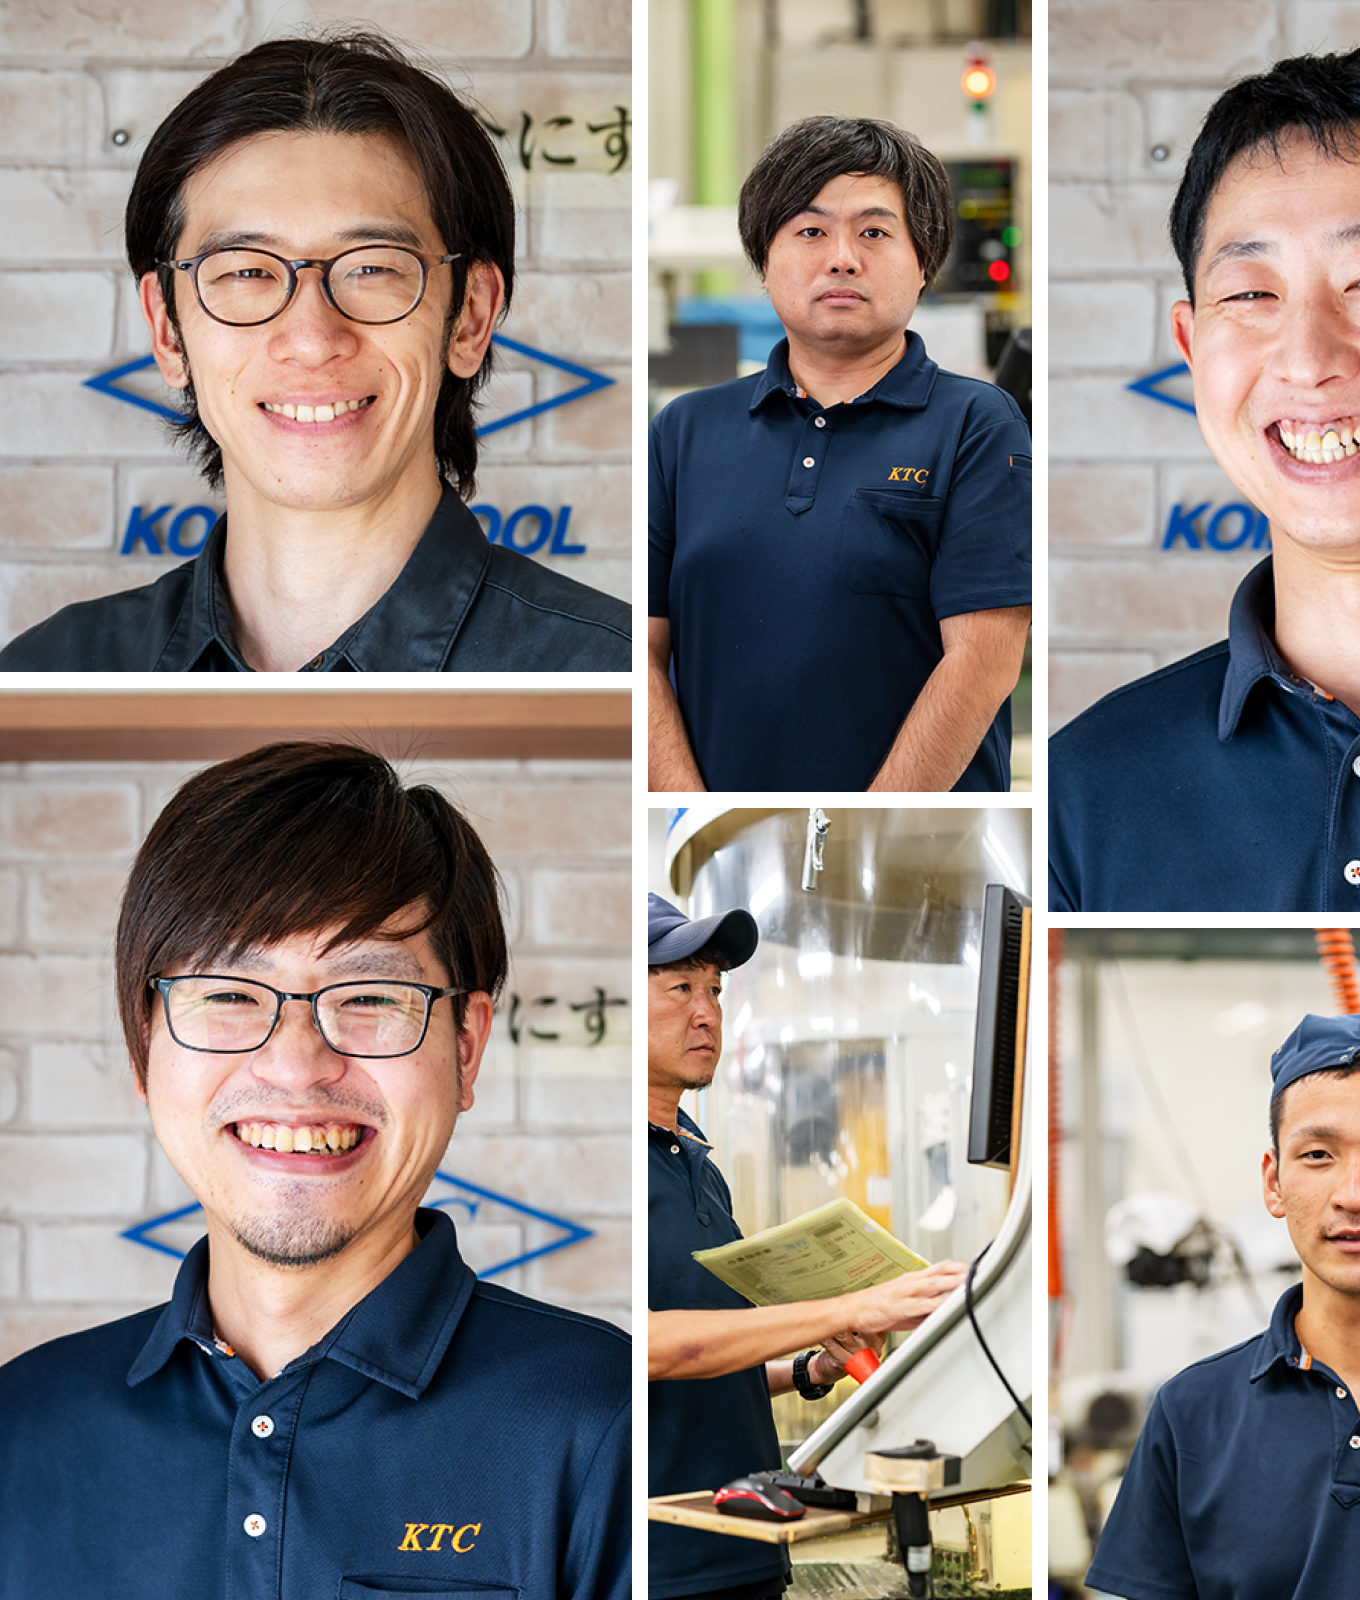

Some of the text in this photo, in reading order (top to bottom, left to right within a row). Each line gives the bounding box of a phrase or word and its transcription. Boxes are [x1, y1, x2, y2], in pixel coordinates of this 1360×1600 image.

[888, 466, 930, 485] KTC
[120, 504, 587, 557] KO OOL
[1162, 502, 1272, 552] KOI
[508, 986, 629, 1047] にす
[397, 1522, 482, 1553] KTC
